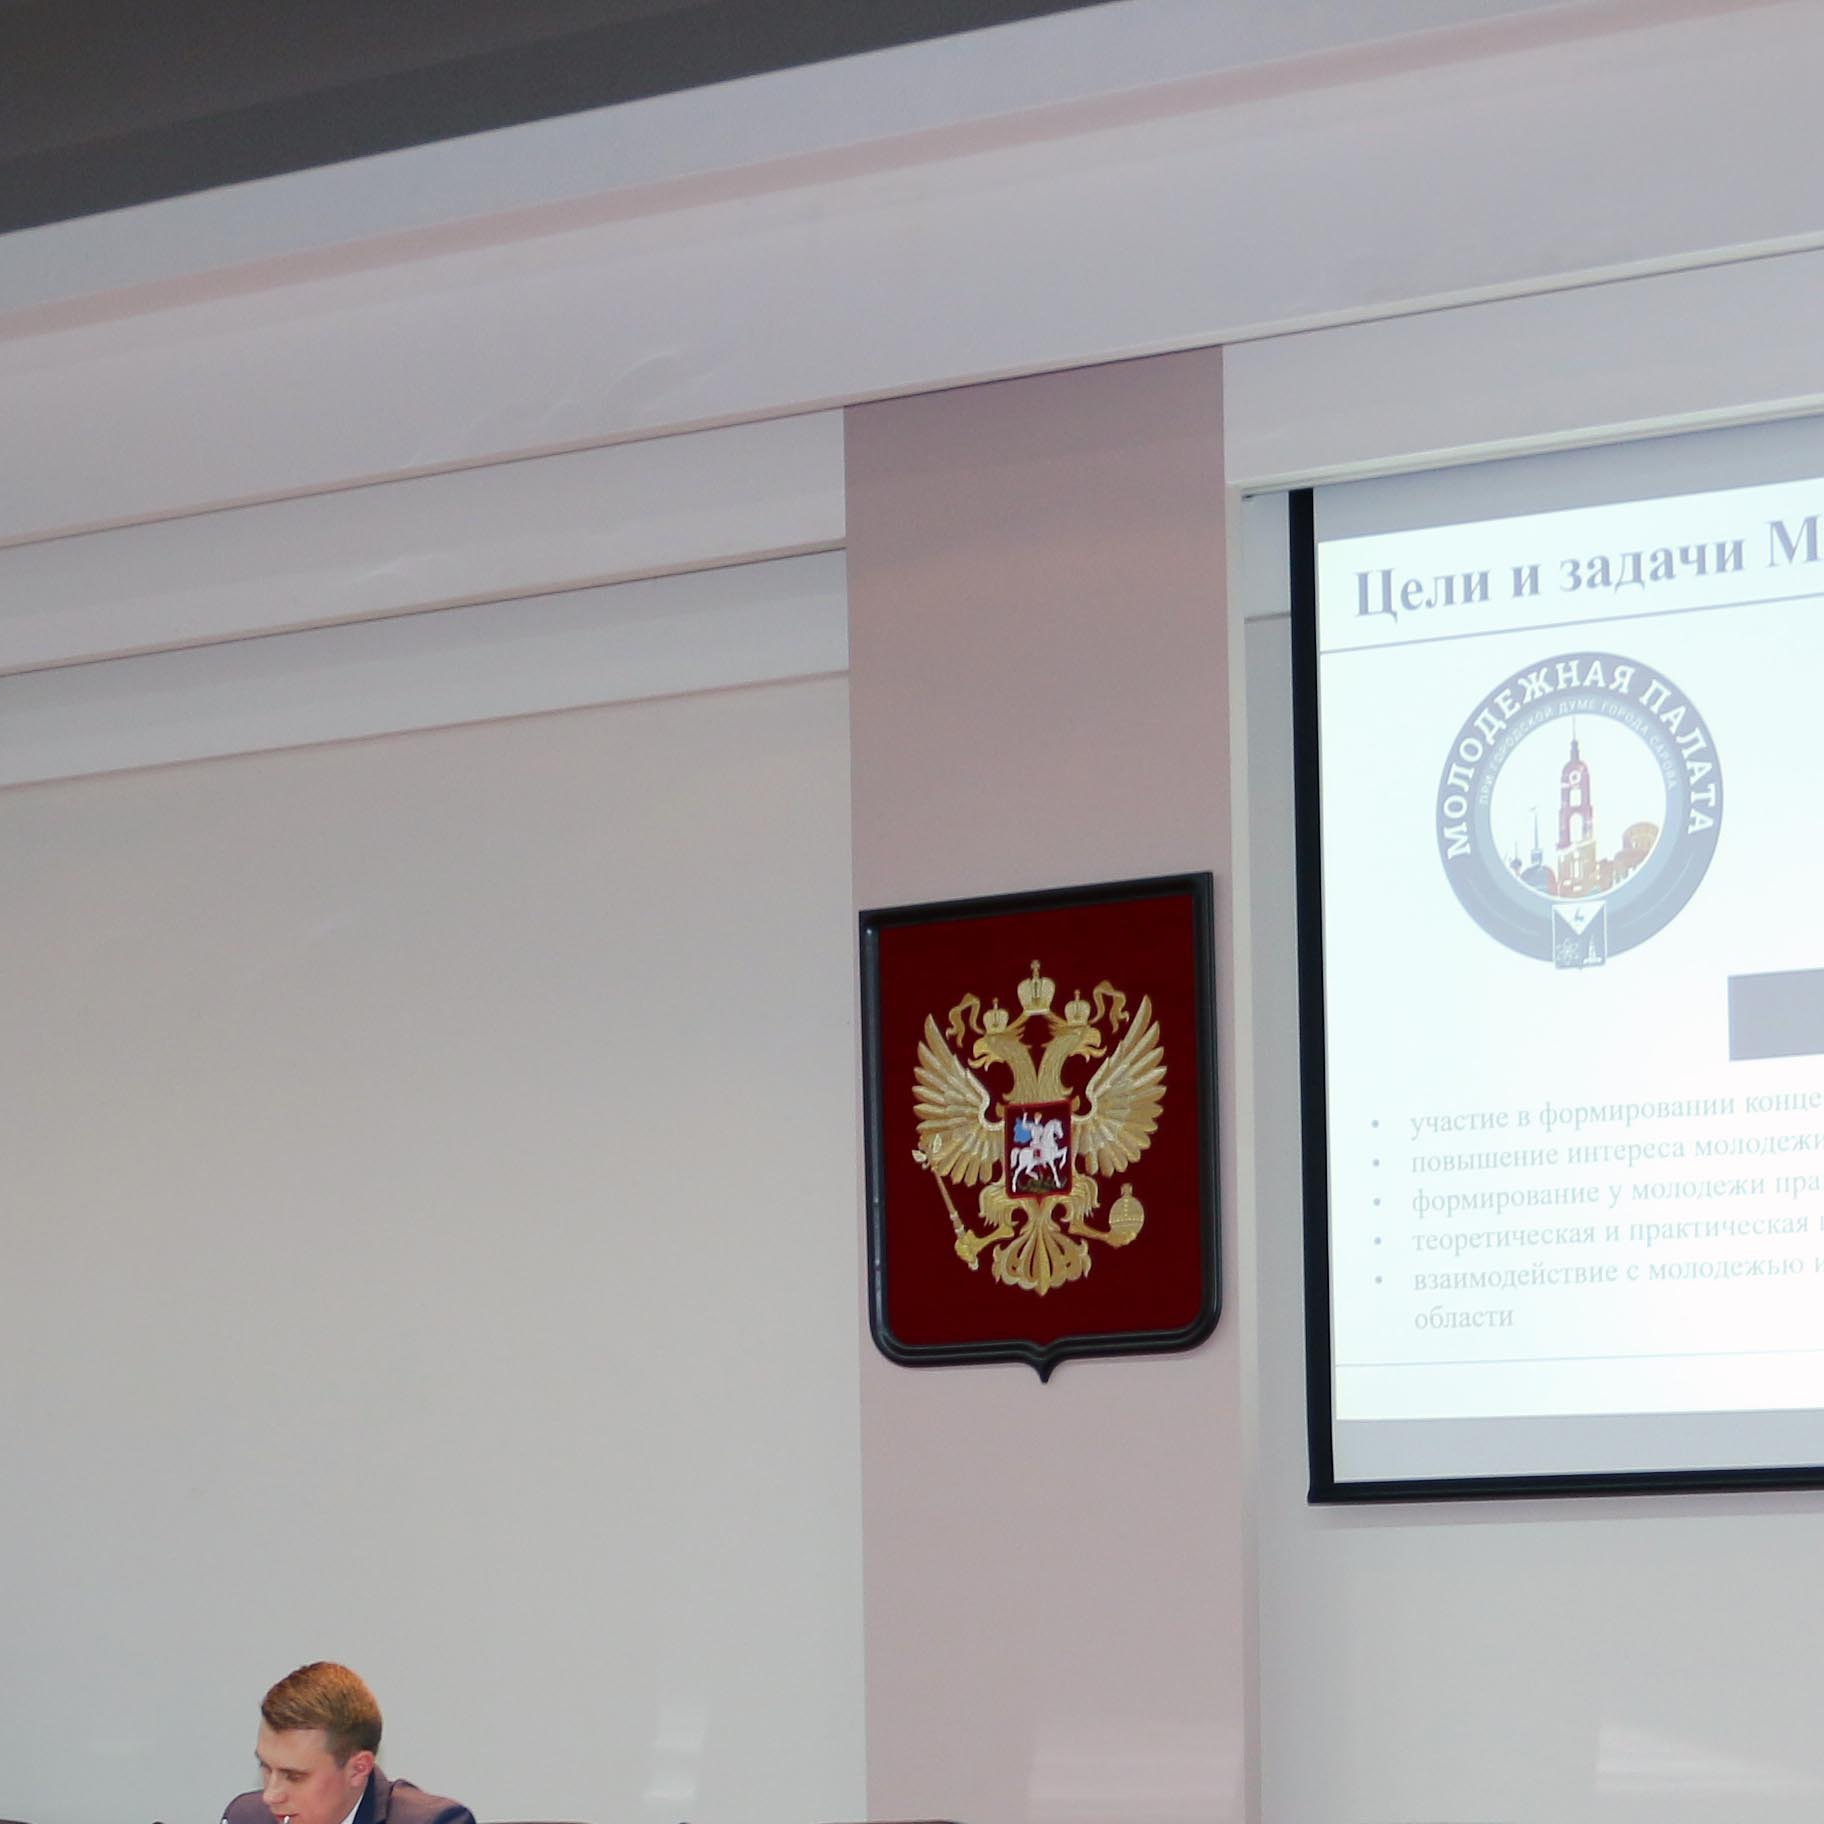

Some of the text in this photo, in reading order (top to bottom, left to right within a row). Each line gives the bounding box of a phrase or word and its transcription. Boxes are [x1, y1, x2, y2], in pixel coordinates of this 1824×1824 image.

[1354, 567, 1490, 624] Цели
[1512, 564, 1541, 598] и
[1560, 539, 1745, 592] задачи
[1558, 699, 1596, 714] ДУМЕ
[1443, 660, 1717, 860] МОЛОДЕЖНАЯ ПАЛАТА
[1410, 1111, 1509, 1139] участие
[1517, 1110, 1531, 1128] в
[1539, 1096, 1735, 1137] формировании
[1412, 1147, 1558, 1173] повышение
[1568, 1141, 1685, 1167] интереса
[1412, 1184, 1599, 1219] формирование
[1608, 1186, 1623, 1209] у
[1632, 1176, 1765, 1202] молодежи
[1412, 1227, 1595, 1257] теоретическая
[1606, 1225, 1620, 1243] и
[1629, 1216, 1809, 1247] практическая
[1415, 1259, 1618, 1291] взаимодействие
[1626, 1263, 1639, 1281] с
[1649, 1253, 1803, 1281] молодежью
[1415, 1306, 1513, 1330] области
